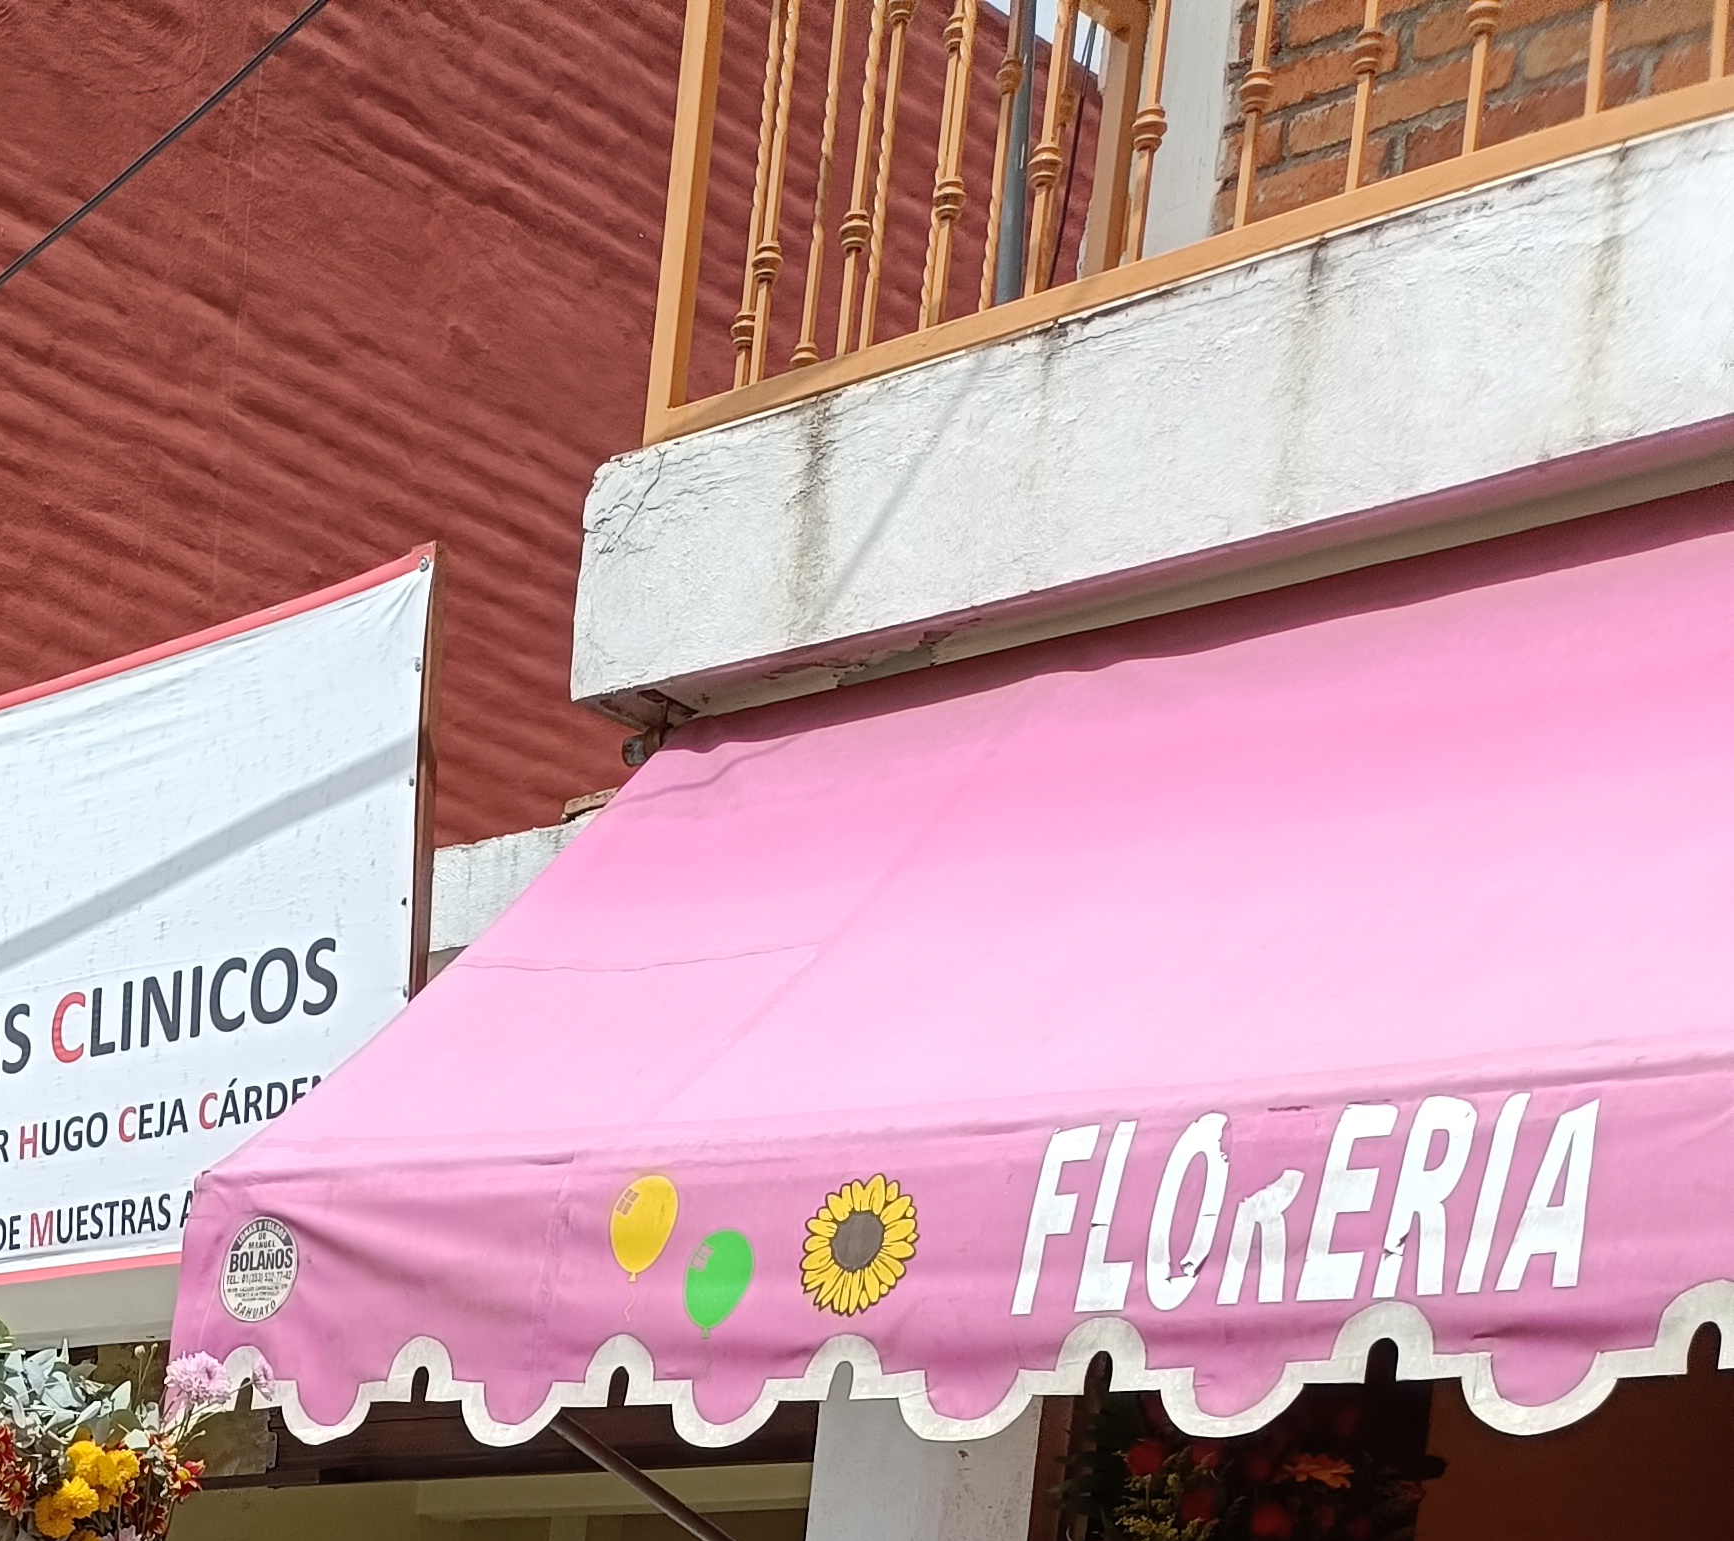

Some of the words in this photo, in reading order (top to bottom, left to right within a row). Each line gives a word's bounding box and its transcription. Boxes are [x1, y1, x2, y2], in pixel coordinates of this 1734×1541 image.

[52, 937, 338, 1064] CLINICOS
[19, 1111, 109, 1160] HUGO
[118, 1098, 188, 1143] CEJA
[29, 1193, 171, 1249] MUESTRAS
[1010, 1092, 1601, 1316] FLORERIA
[229, 1248, 294, 1273] BOLAÑOS
[248, 1240, 276, 1249] MANUEL
[234, 1300, 276, 1318] SAHUAYO
